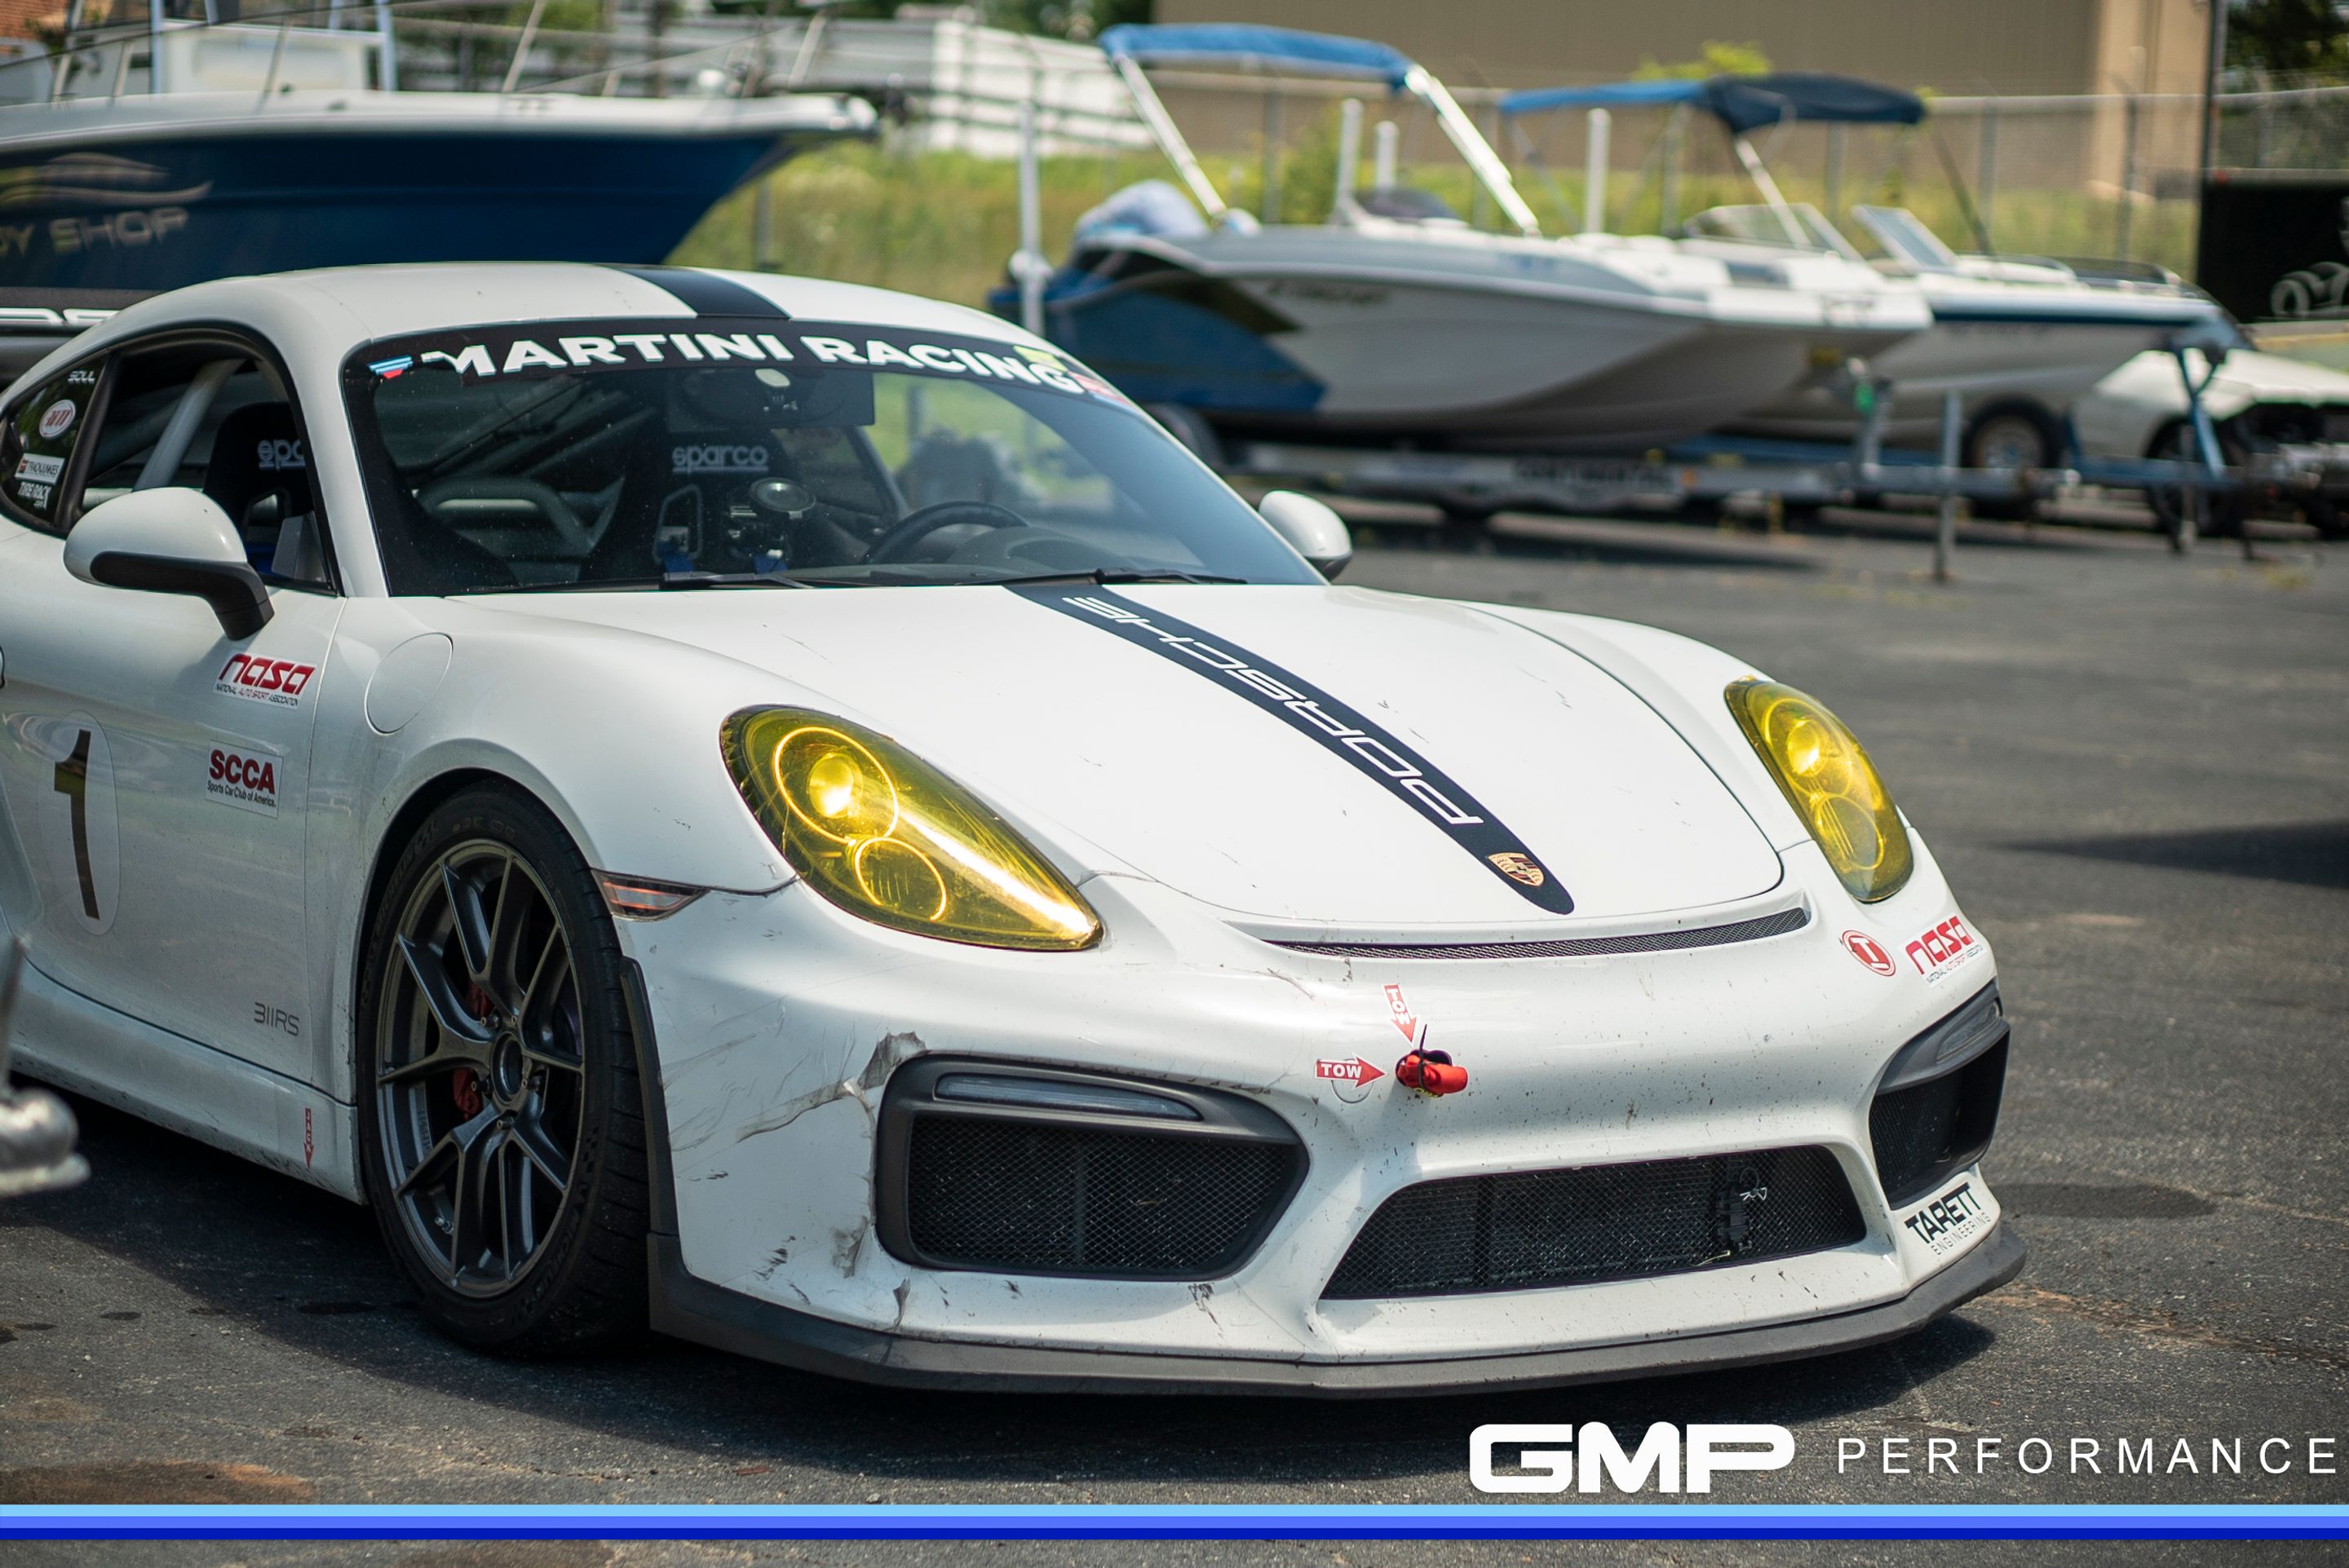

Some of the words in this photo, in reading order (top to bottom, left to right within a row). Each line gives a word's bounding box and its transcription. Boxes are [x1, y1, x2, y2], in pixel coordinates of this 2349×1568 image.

[50, 207, 188, 254] SHOP
[421, 333, 794, 377] MARTINI
[800, 335, 1085, 395] RACING
[672, 446, 768, 474] sparco
[1063, 596, 1484, 825] PORSCHE
[207, 780, 223, 794] Sports
[224, 784, 234, 796] Car
[234, 787, 246, 800] Club
[209, 749, 276, 794] SCCA
[54, 729, 100, 920] 1
[1387, 988, 1412, 1025] TOW
[1320, 1063, 1363, 1079] TOW
[1904, 1182, 1981, 1244] TARETT
